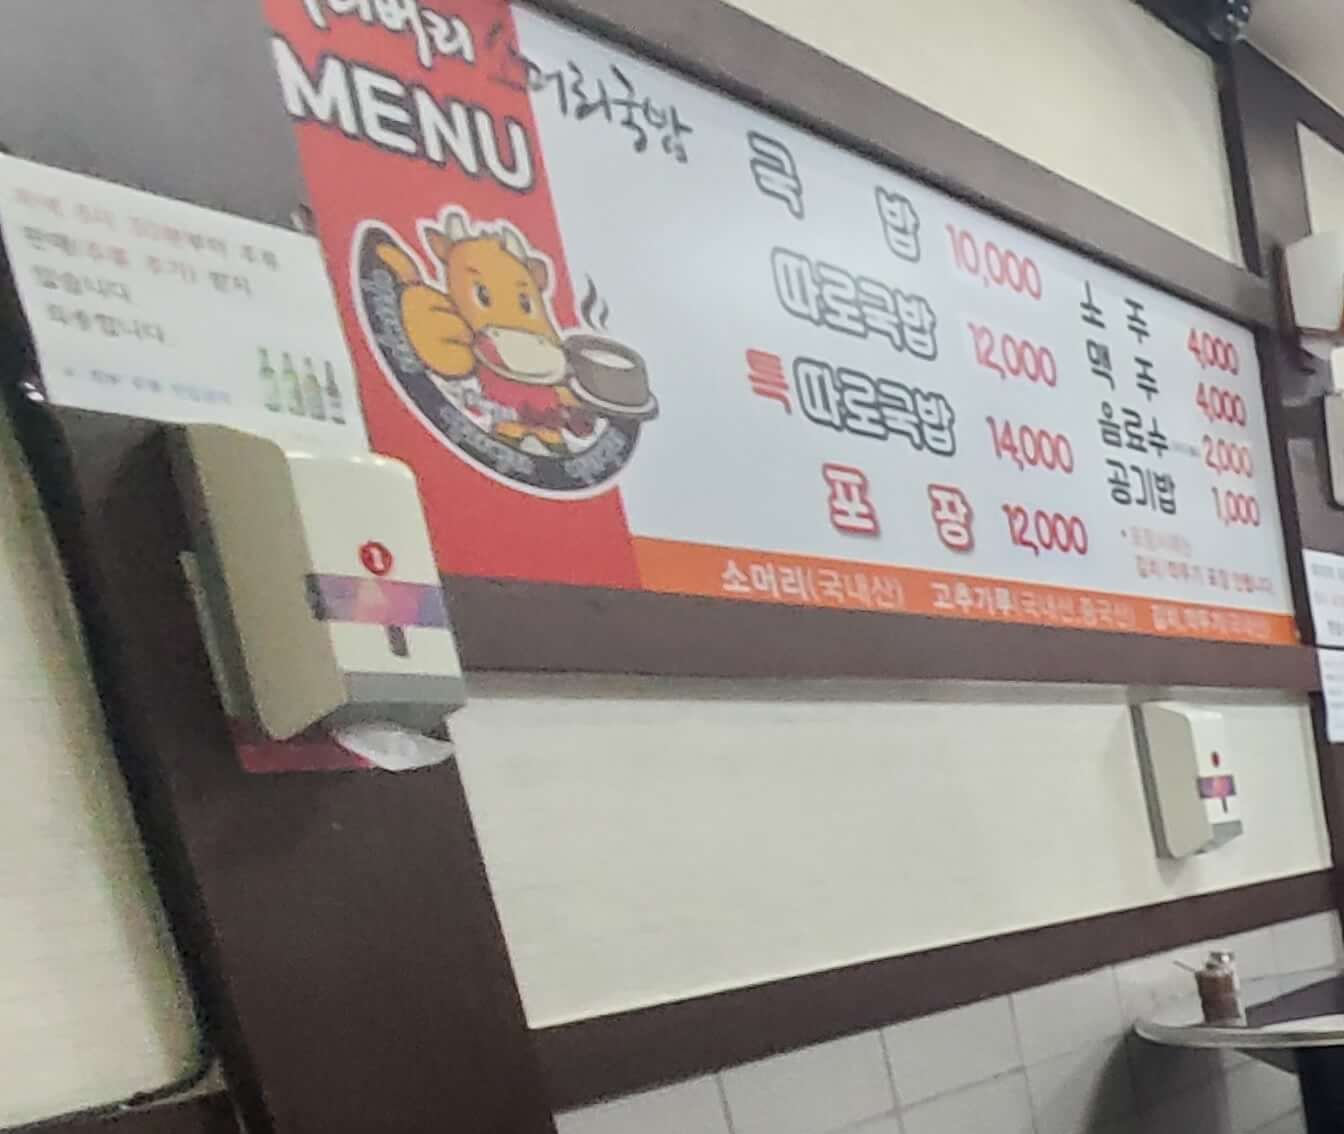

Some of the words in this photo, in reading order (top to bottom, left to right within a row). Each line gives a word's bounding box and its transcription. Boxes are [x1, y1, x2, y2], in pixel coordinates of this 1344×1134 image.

[270, 35, 535, 193] MENU
[747, 130, 804, 220] 국
[874, 184, 921, 263] 밥
[945, 221, 1043, 301] 10,000
[770, 246, 938, 362] 따로국밥
[966, 320, 1058, 389] 12,000
[1123, 297, 1151, 344] 주
[1187, 327, 1240, 377] 4,000
[792, 355, 957, 458] 따로국밥
[985, 415, 1075, 475] 14,000
[1097, 400, 1170, 460] 음료수
[1202, 433, 1254, 479] 2,000
[1133, 356, 1160, 402] 주
[1195, 381, 1248, 428] 4,000
[821, 462, 881, 537] 포
[927, 482, 976, 553] 장
[1001, 502, 1089, 557] 12,000
[1105, 457, 1177, 516] 공기밥
[1211, 485, 1262, 529] 1,000
